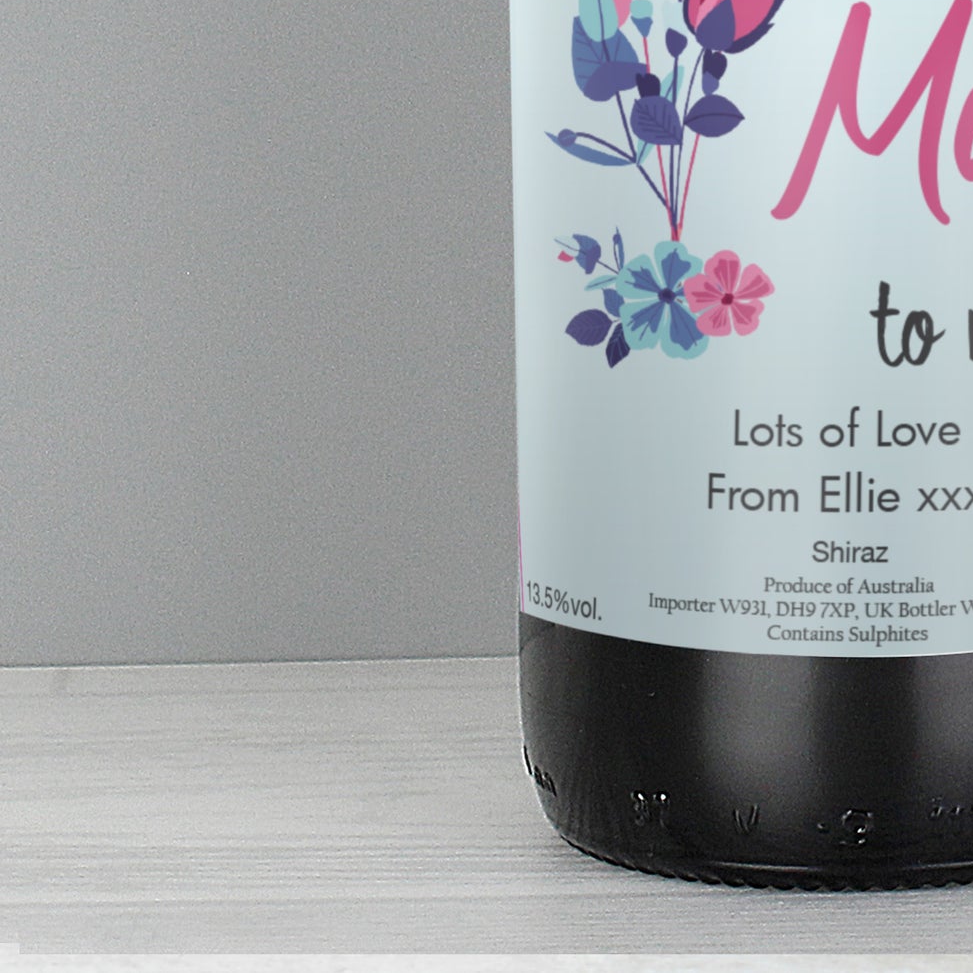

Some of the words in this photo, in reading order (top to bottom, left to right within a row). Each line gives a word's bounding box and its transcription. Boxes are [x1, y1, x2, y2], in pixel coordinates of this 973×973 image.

[869, 280, 946, 368] to
[733, 408, 804, 448] Lots
[819, 405, 861, 448] of
[876, 409, 962, 448] Love
[706, 472, 800, 513] From
[820, 470, 901, 514] Ellie
[811, 540, 889, 564] Shiraz
[526, 580, 602, 621] 13.5%vol.
[763, 577, 832, 593] Produce
[836, 577, 854, 594] of
[857, 576, 935, 594] Australia
[648, 592, 716, 615] Importer
[775, 600, 816, 618] DH9
[820, 601, 859, 620] 7XP,
[864, 601, 893, 618] UK
[898, 600, 957, 618] Bottler
[766, 624, 844, 642] Contains
[848, 625, 929, 647] Sulphites
